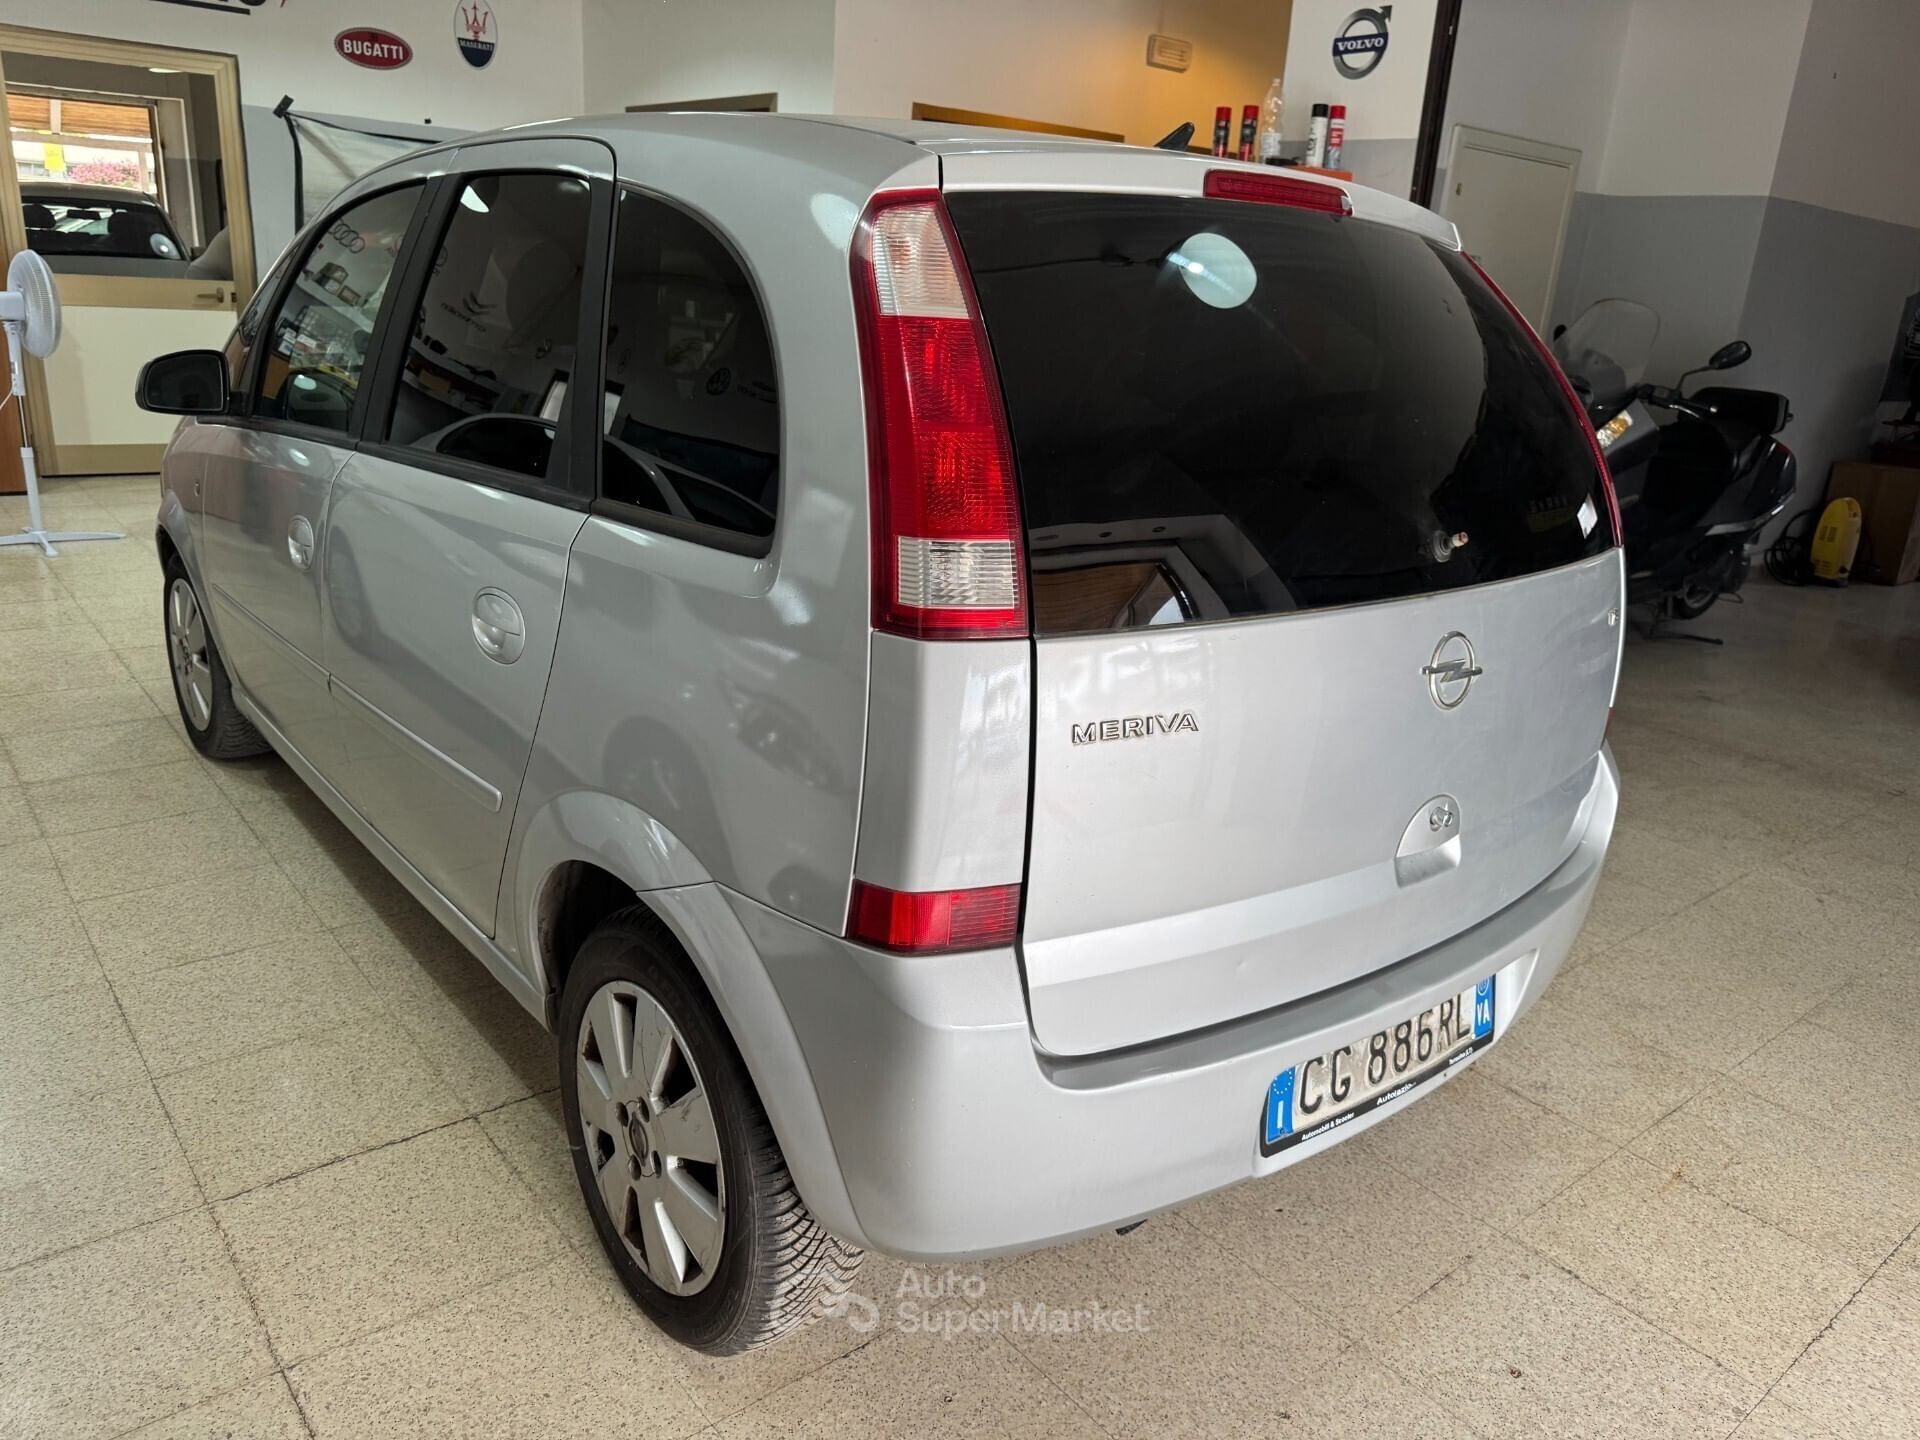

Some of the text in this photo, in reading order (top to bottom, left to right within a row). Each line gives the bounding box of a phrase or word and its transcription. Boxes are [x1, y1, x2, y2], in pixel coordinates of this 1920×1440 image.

[342, 38, 404, 61] BUGATTI
[1336, 37, 1385, 51] VOLVO
[1071, 712, 1199, 744] MERIVA
[1476, 999, 1491, 1026] VA
